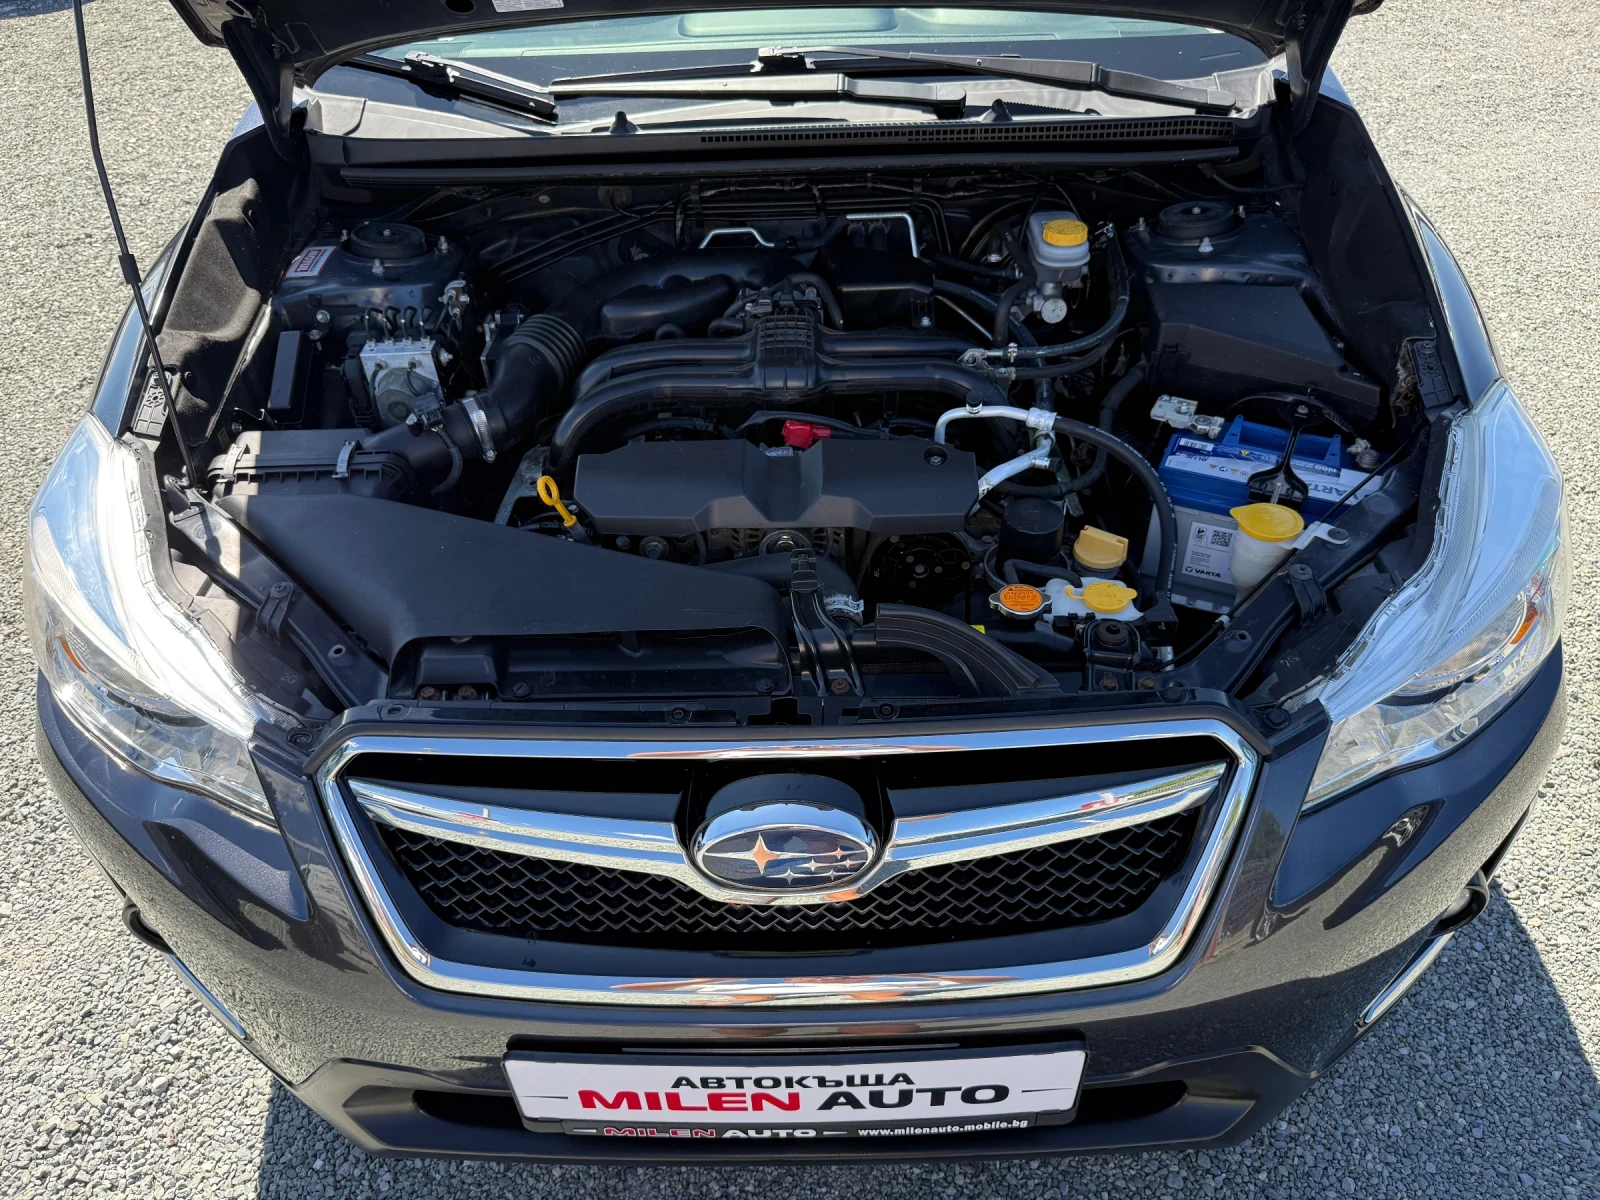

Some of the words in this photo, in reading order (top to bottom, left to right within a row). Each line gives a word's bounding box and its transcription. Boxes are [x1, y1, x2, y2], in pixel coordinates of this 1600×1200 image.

[1194, 568, 1222, 578] VARTA
[577, 1089, 801, 1112] MILEN
[816, 1084, 1010, 1111] AUTO
[603, 1127, 716, 1137] MILEN
[721, 1128, 817, 1138] AUTO
[857, 1119, 1028, 1137] www.milenauto.mobile.bg
